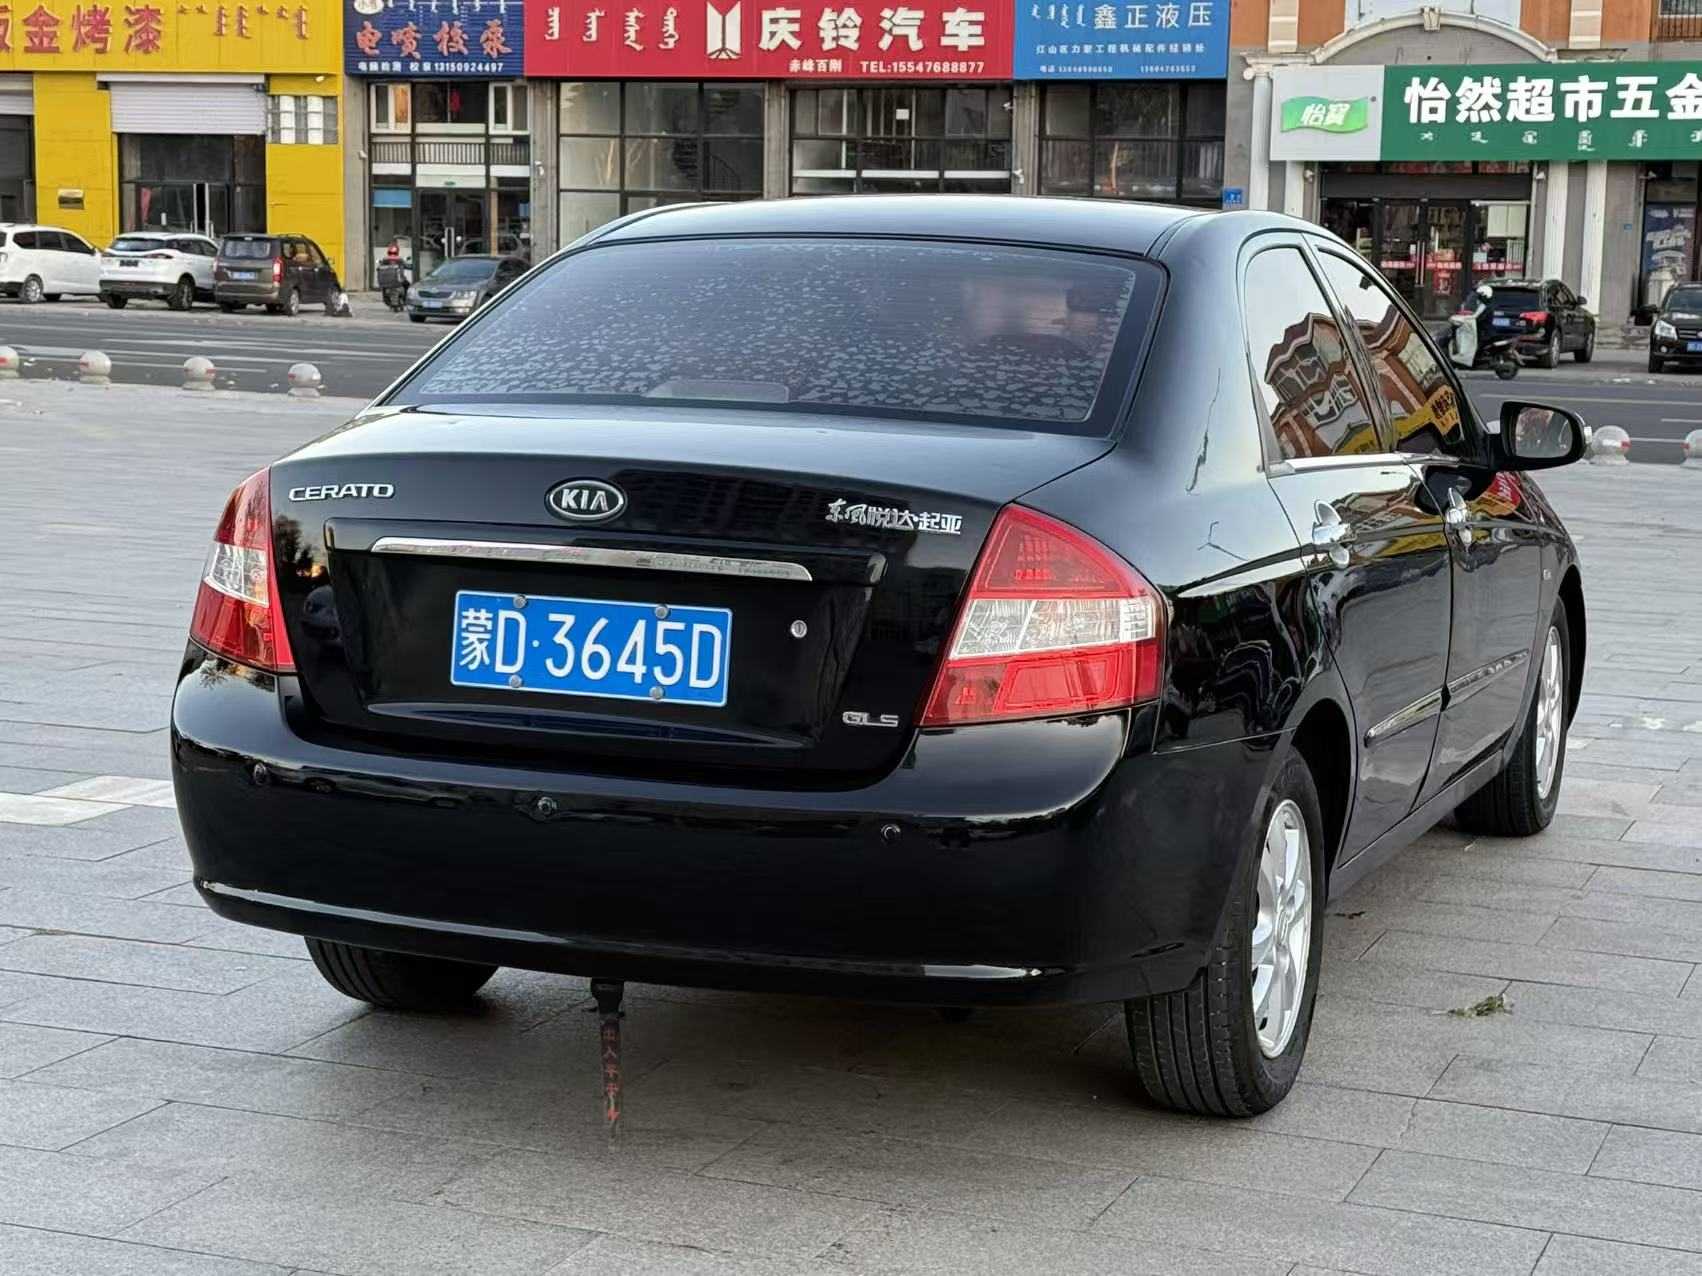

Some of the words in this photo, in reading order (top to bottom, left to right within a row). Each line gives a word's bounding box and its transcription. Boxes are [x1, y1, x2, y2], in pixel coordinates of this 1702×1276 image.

[758, 7, 985, 51] 庆铃汽车
[1094, 2, 1213, 29] 鑫正液压
[1404, 73, 1702, 123] 怡然超市五金
[288, 483, 395, 501] CERATO
[561, 488, 609, 512] KIA
[459, 607, 723, 688] 蒙D·3645D
[842, 711, 899, 728] GLS
